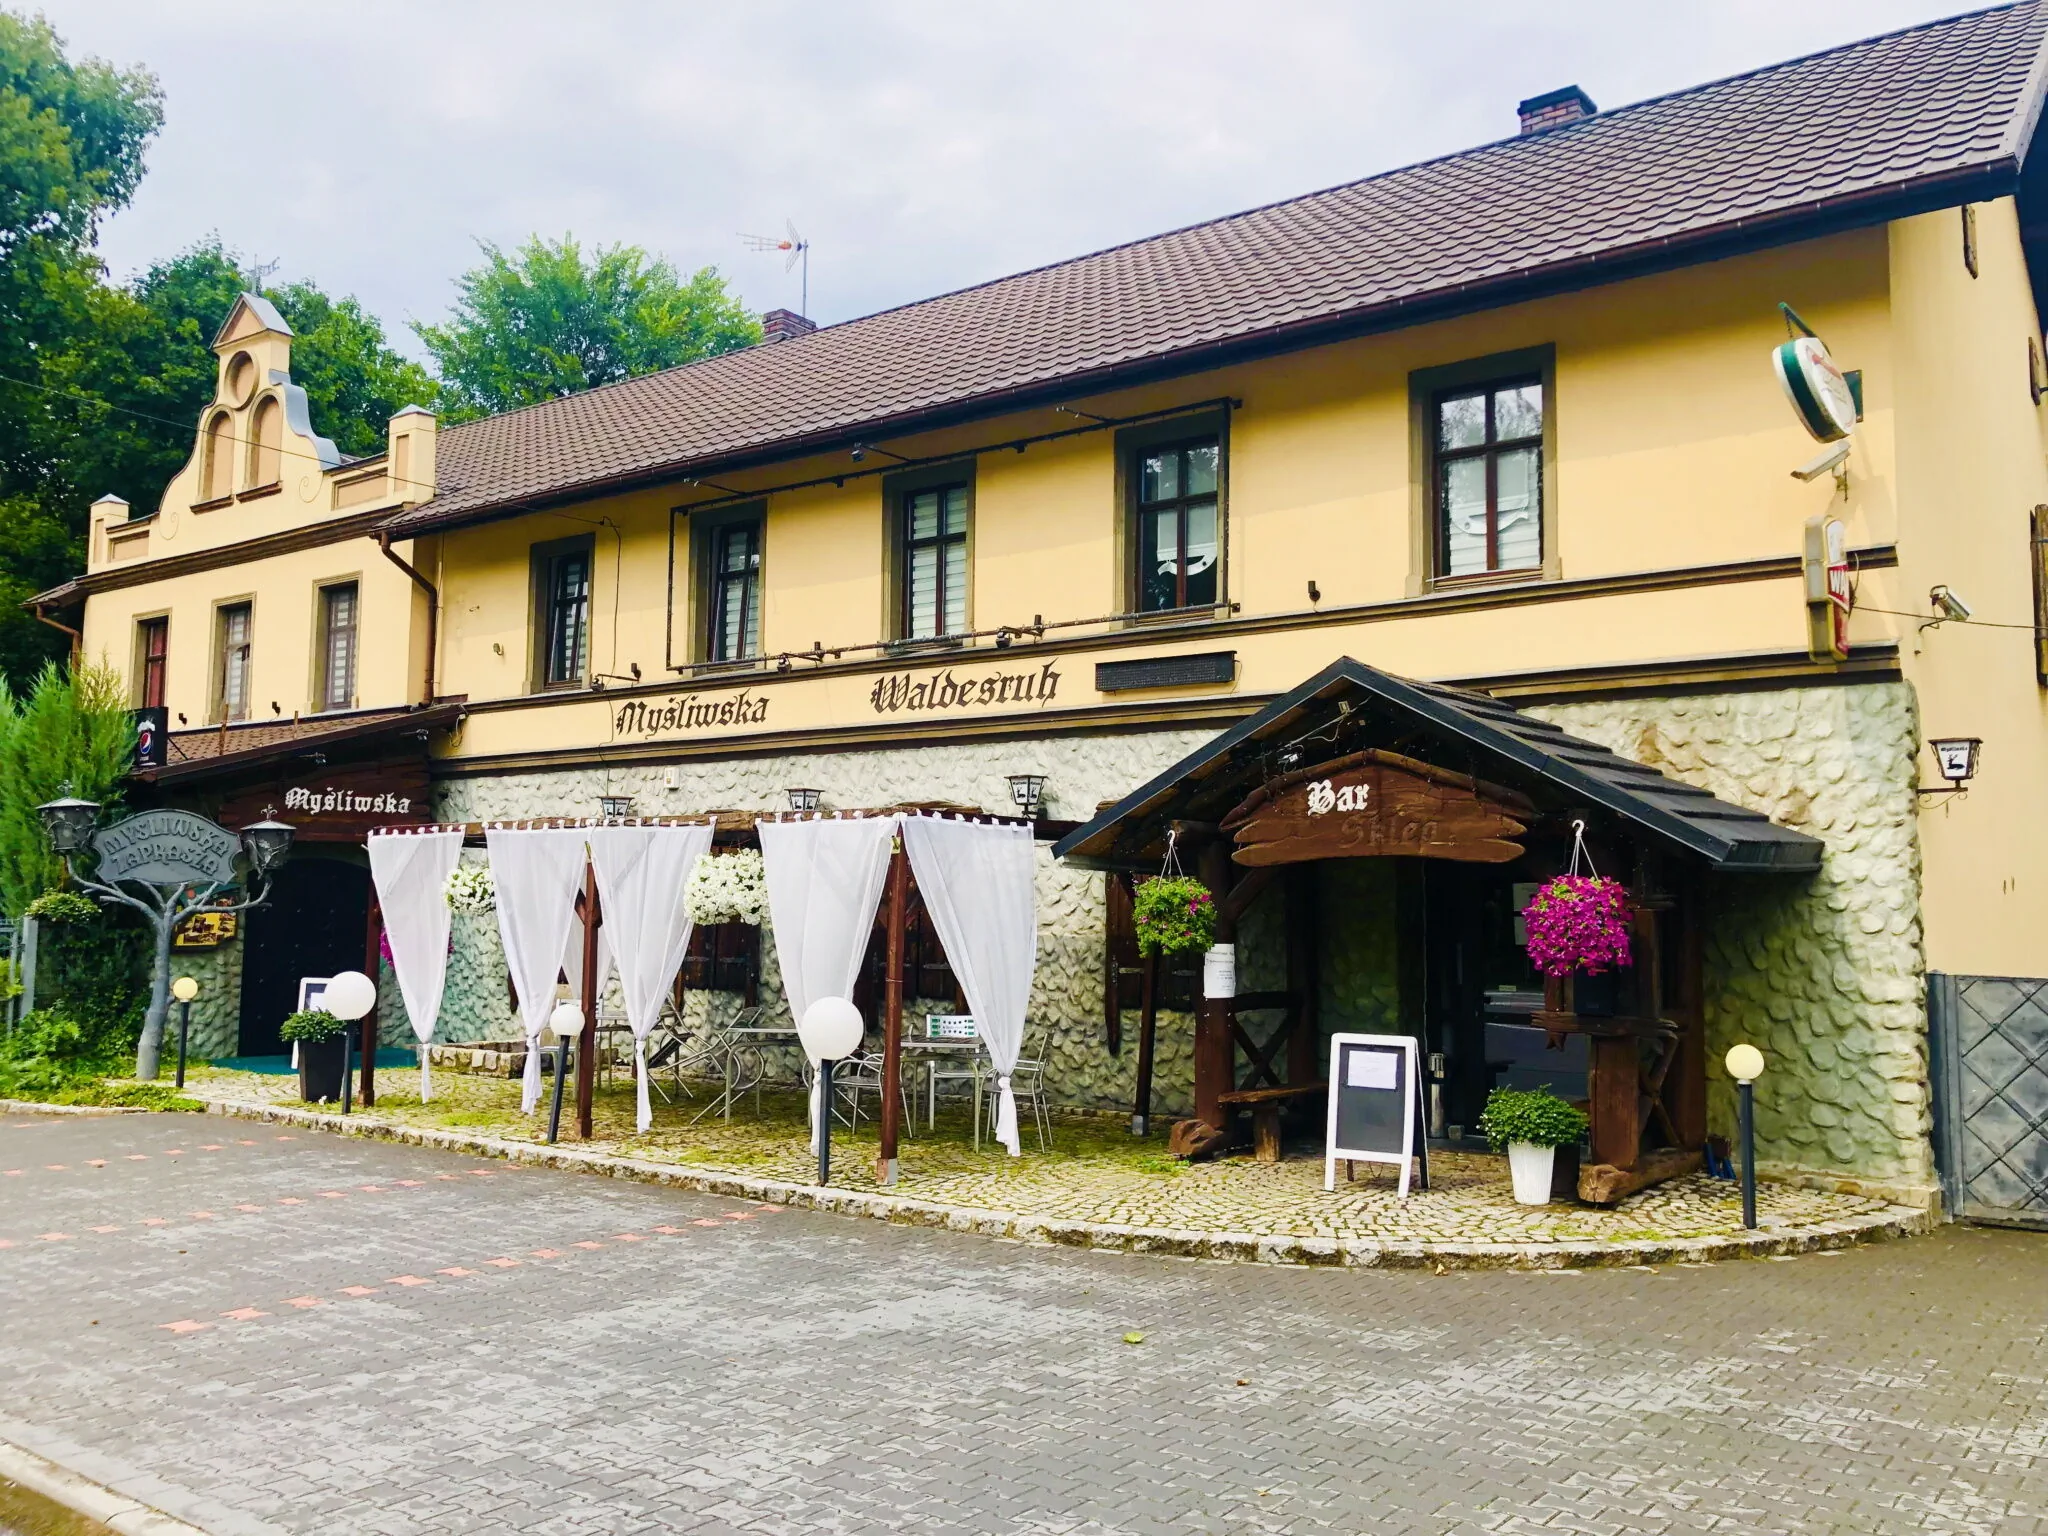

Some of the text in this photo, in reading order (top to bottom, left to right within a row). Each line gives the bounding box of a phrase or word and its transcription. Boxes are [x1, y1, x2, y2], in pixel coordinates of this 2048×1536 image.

[616, 658, 1061, 740] Myśliwska Waldesruh
[285, 787, 411, 815] Myśliwska
[1306, 779, 1369, 816] Bar
[111, 843, 219, 875] ZAPRASZA
